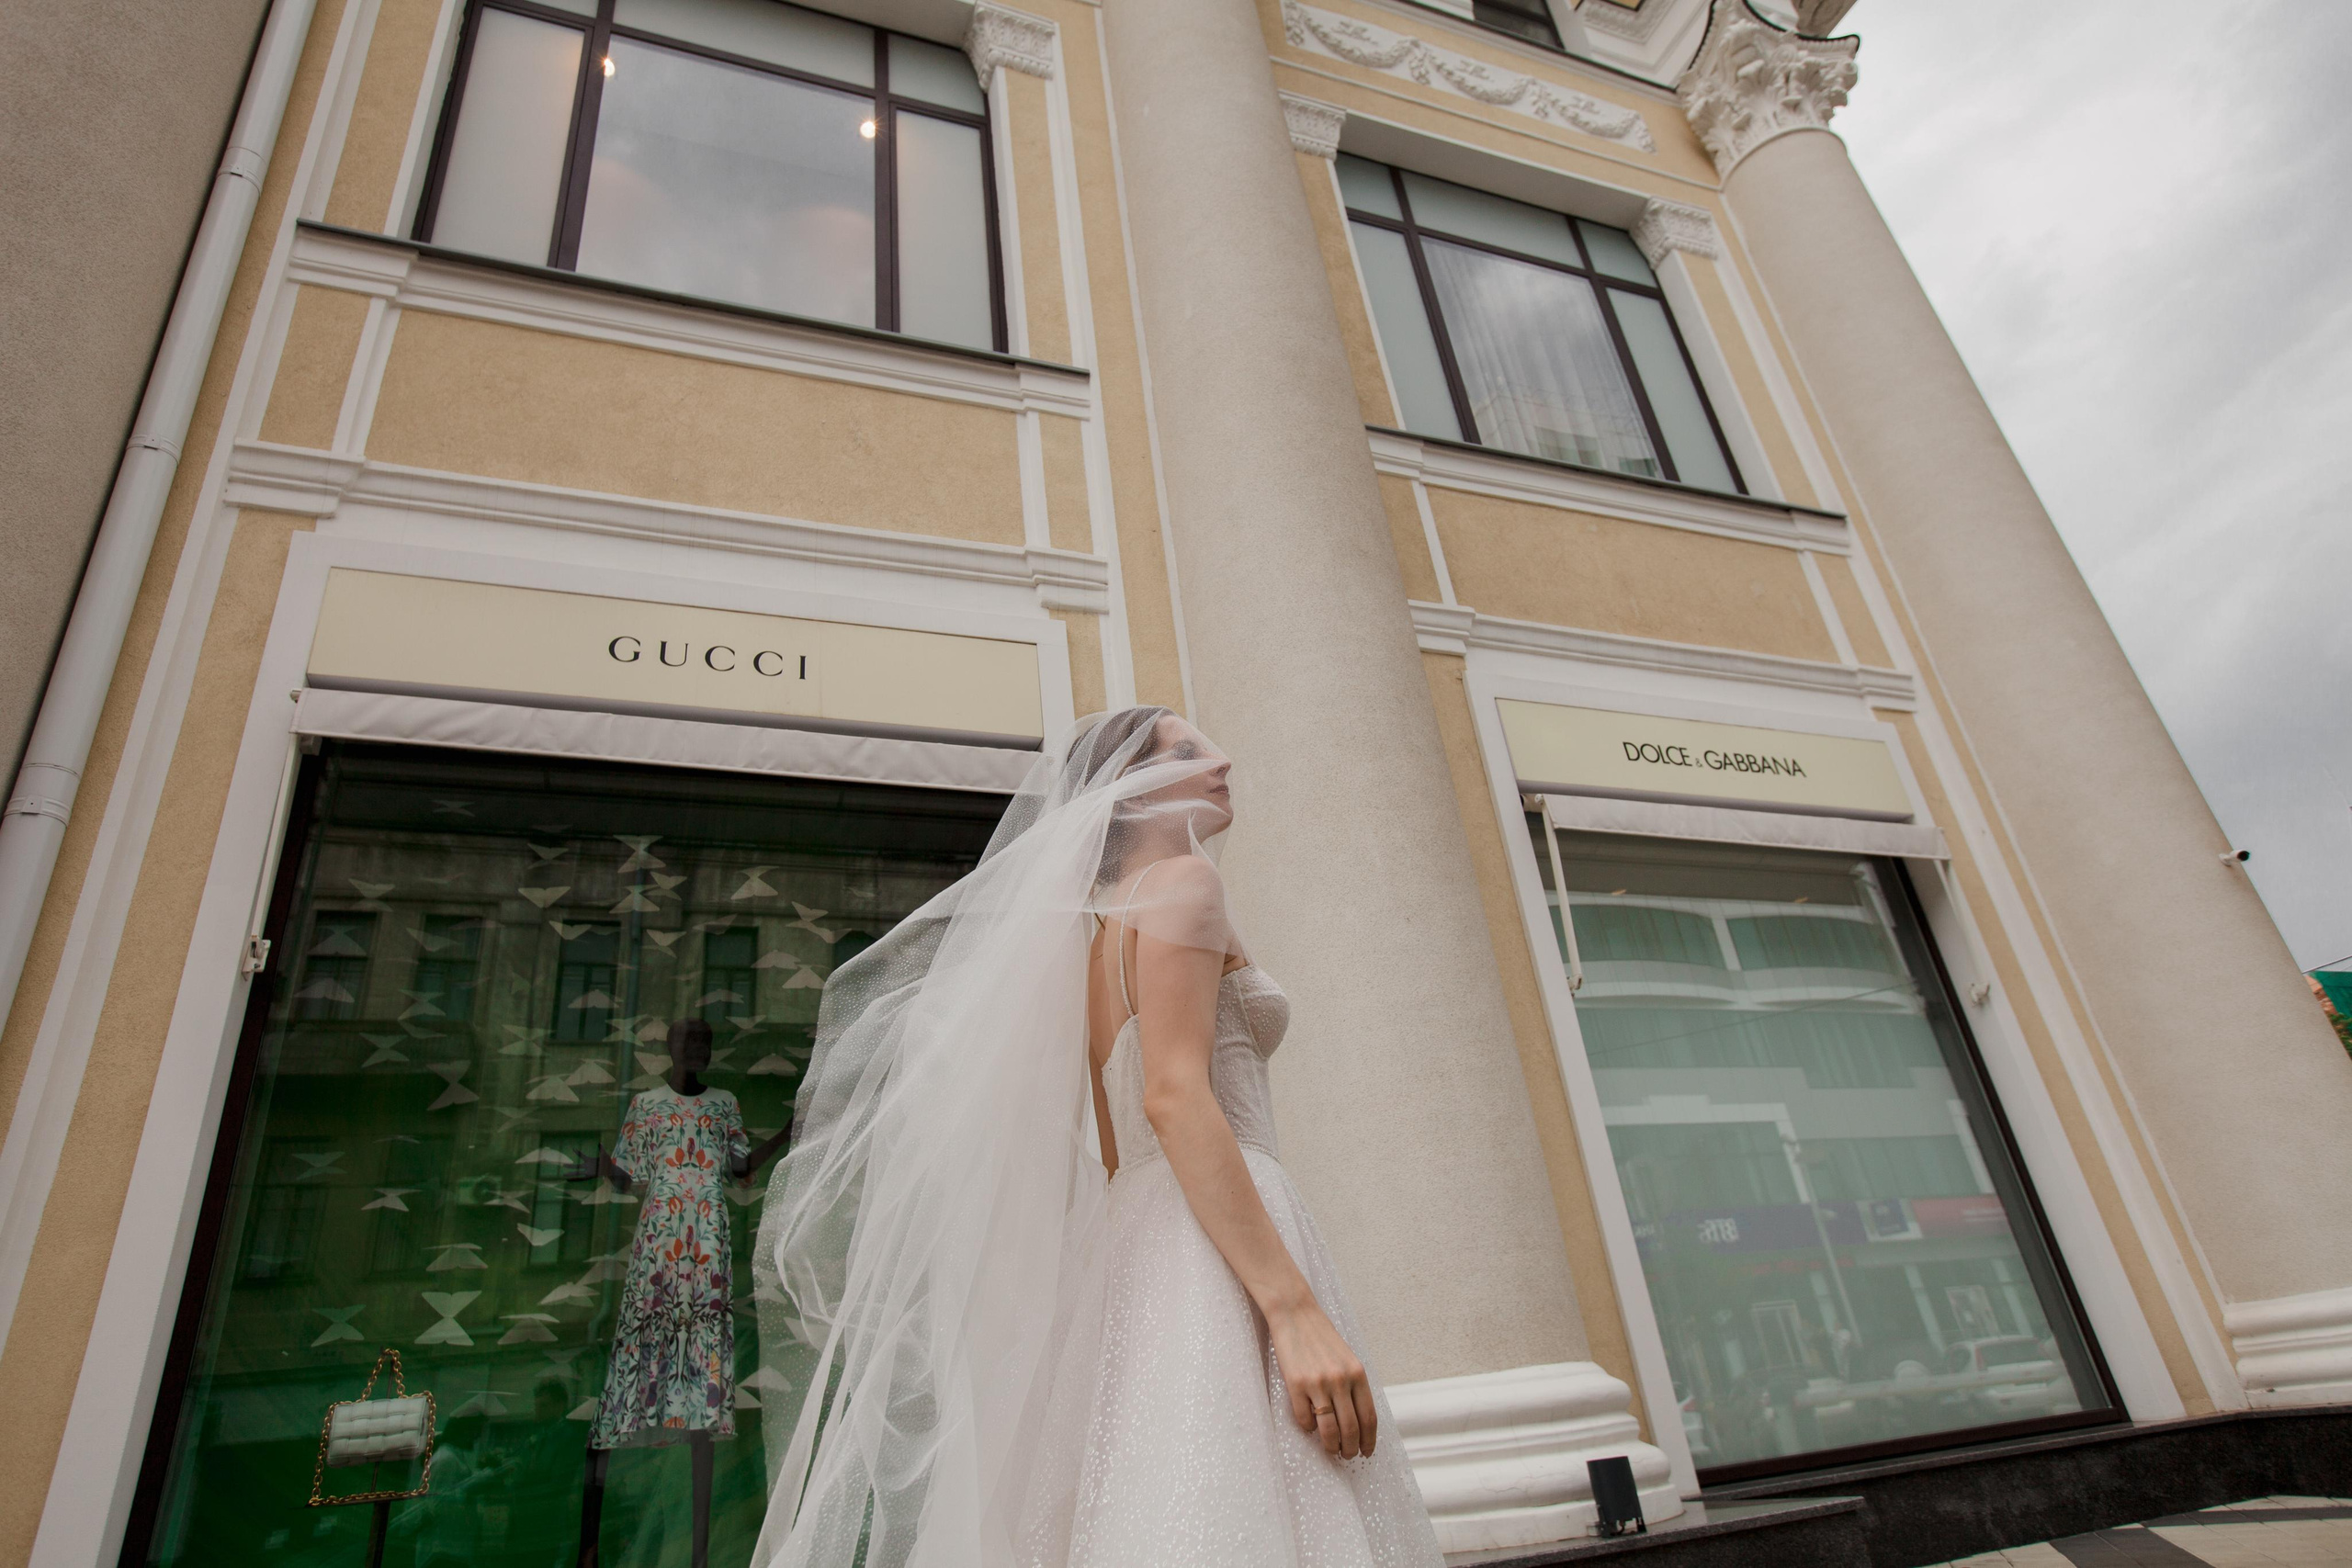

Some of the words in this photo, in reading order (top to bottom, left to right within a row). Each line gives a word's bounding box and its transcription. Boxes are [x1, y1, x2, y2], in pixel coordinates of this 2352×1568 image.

[608, 636, 807, 680] GUCCI
[1623, 741, 1692, 767] DOLCE
[1703, 750, 1807, 778] GABBANA
